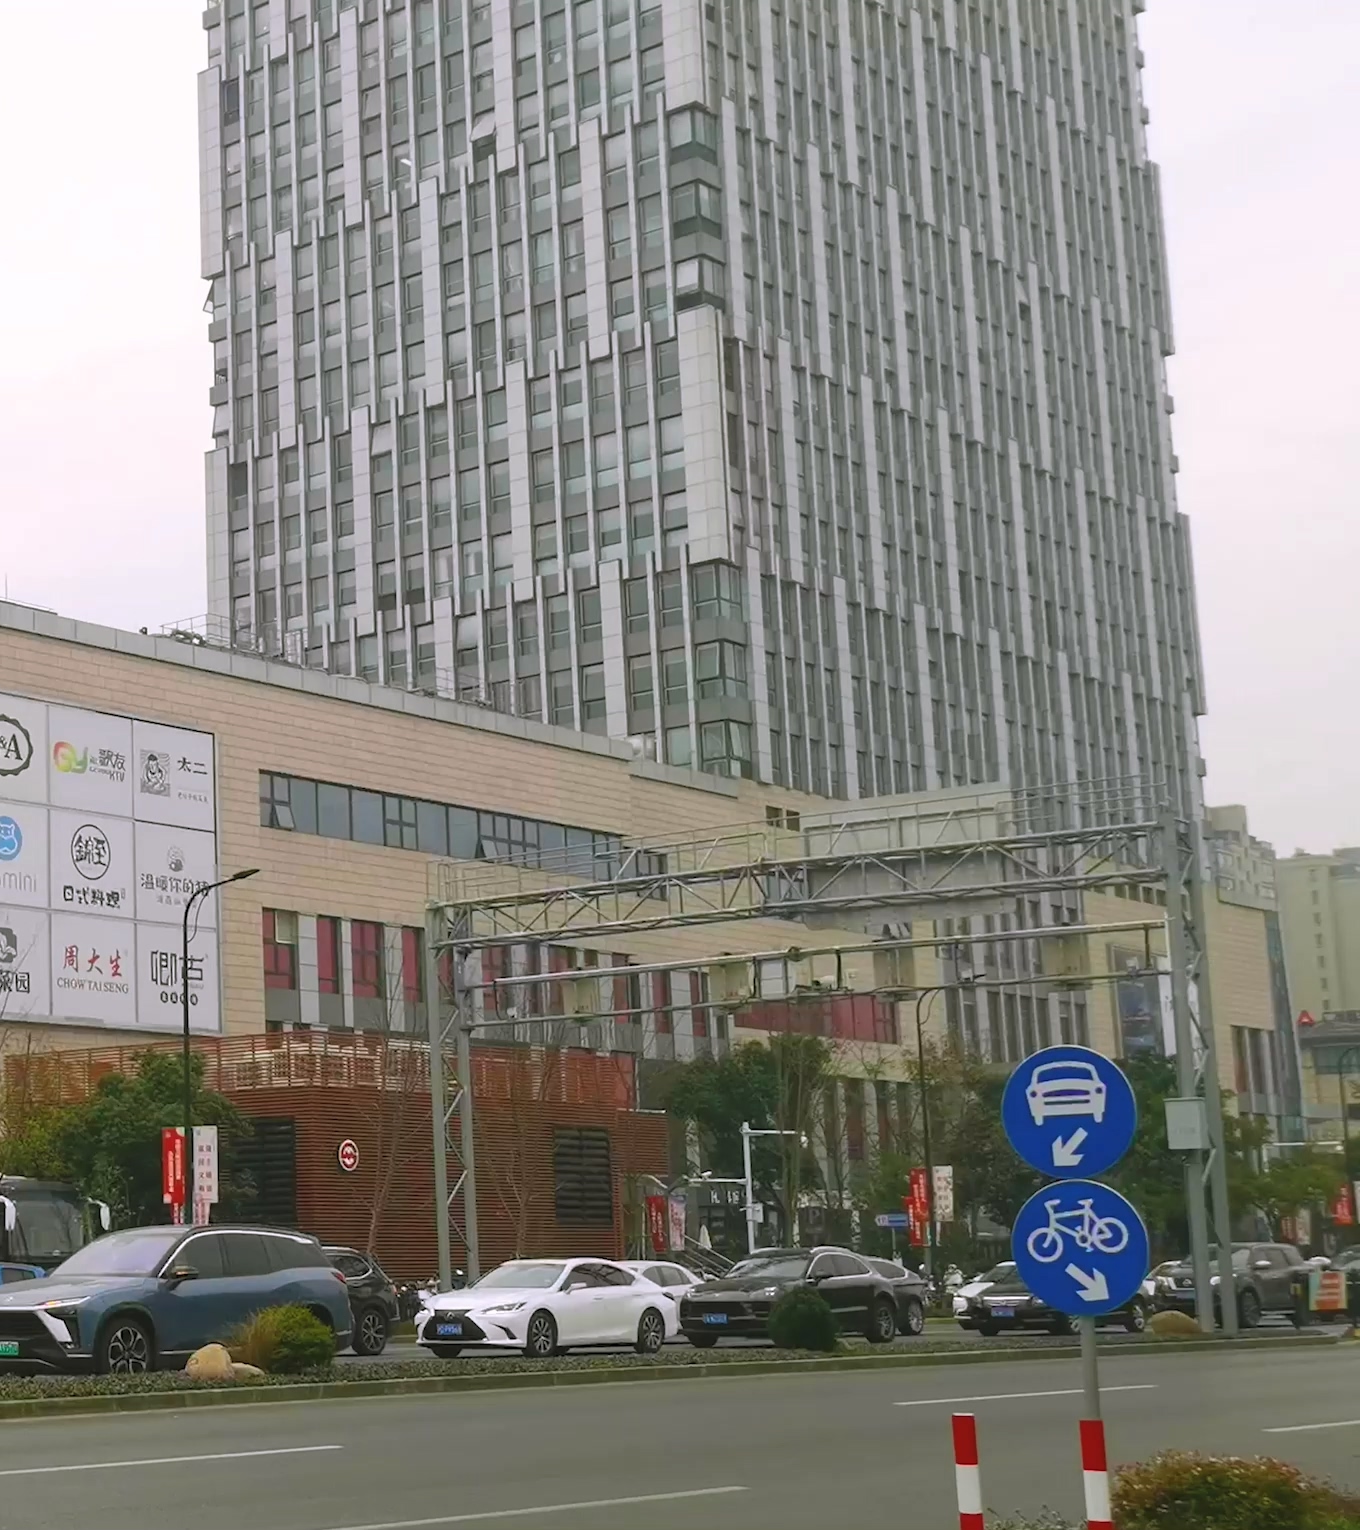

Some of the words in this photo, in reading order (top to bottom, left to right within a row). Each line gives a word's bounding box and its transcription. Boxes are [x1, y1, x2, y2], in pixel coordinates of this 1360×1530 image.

[177, 756, 209, 775] 太二
[63, 885, 121, 909] 日式料理
[63, 944, 123, 977] 周大生
